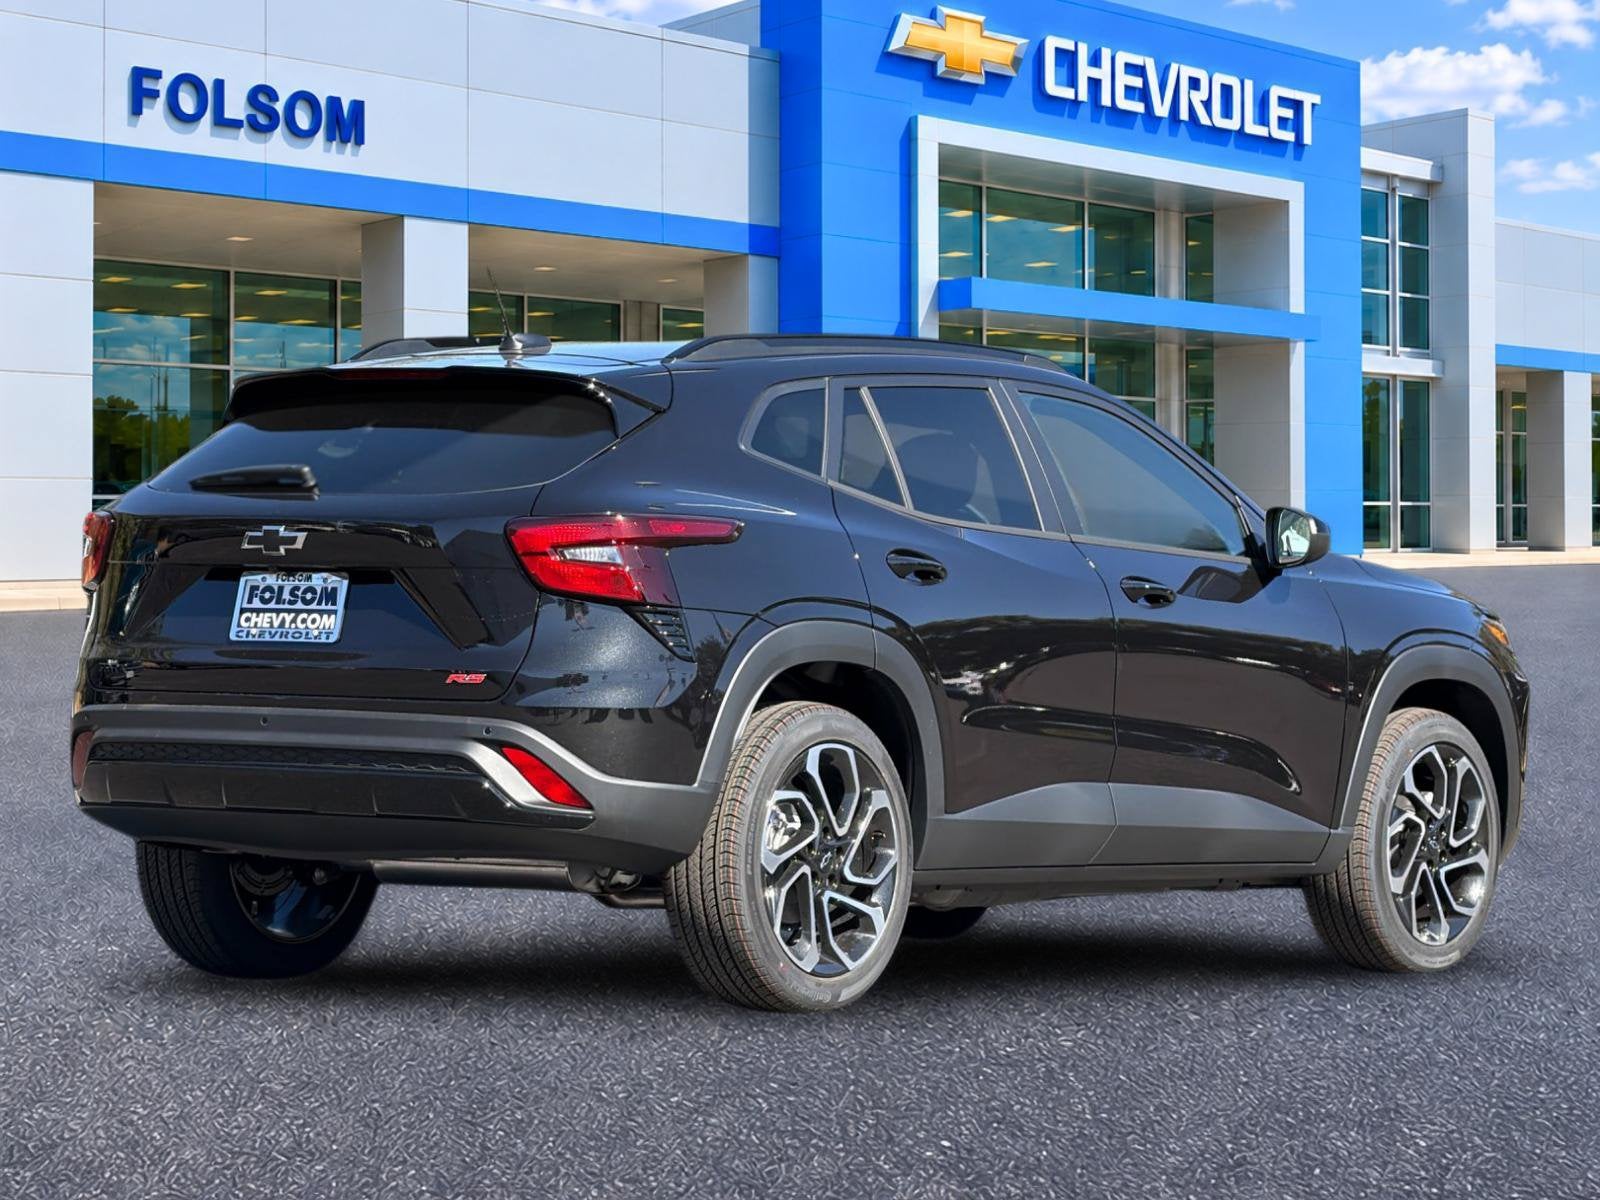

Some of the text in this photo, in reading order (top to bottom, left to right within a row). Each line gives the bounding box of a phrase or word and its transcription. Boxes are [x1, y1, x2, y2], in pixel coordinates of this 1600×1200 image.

[1043, 35, 1321, 146] CHEVROLET
[130, 66, 365, 145] FOLSOM
[275, 572, 313, 583] FOLSOM
[246, 585, 338, 606] FOLSOM
[240, 612, 336, 630] CHEVY.COM
[235, 629, 334, 640] CHEVROLET
[445, 673, 487, 684] RS
